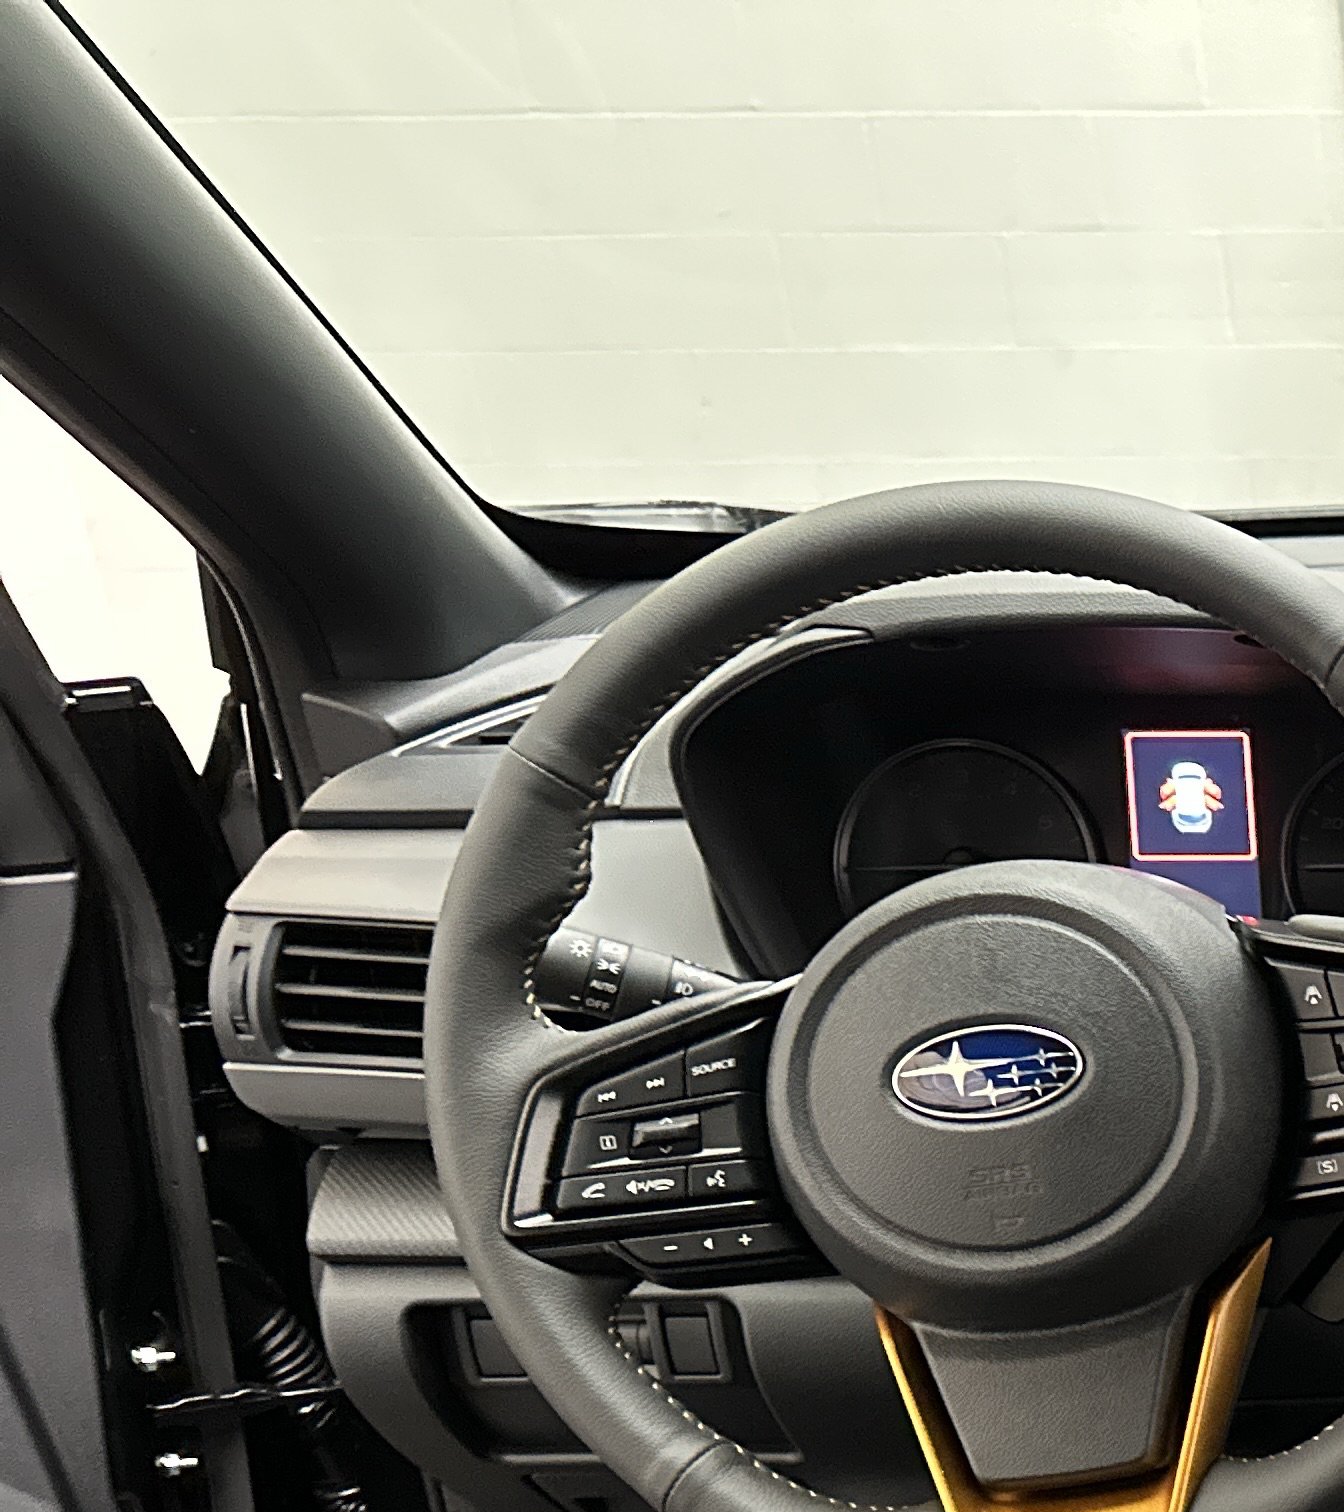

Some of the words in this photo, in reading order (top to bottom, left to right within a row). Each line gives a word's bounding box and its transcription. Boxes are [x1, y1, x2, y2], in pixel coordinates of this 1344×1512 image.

[589, 979, 618, 994] AUTO
[585, 997, 611, 1011] OFF
[691, 1057, 737, 1077] SOURCE
